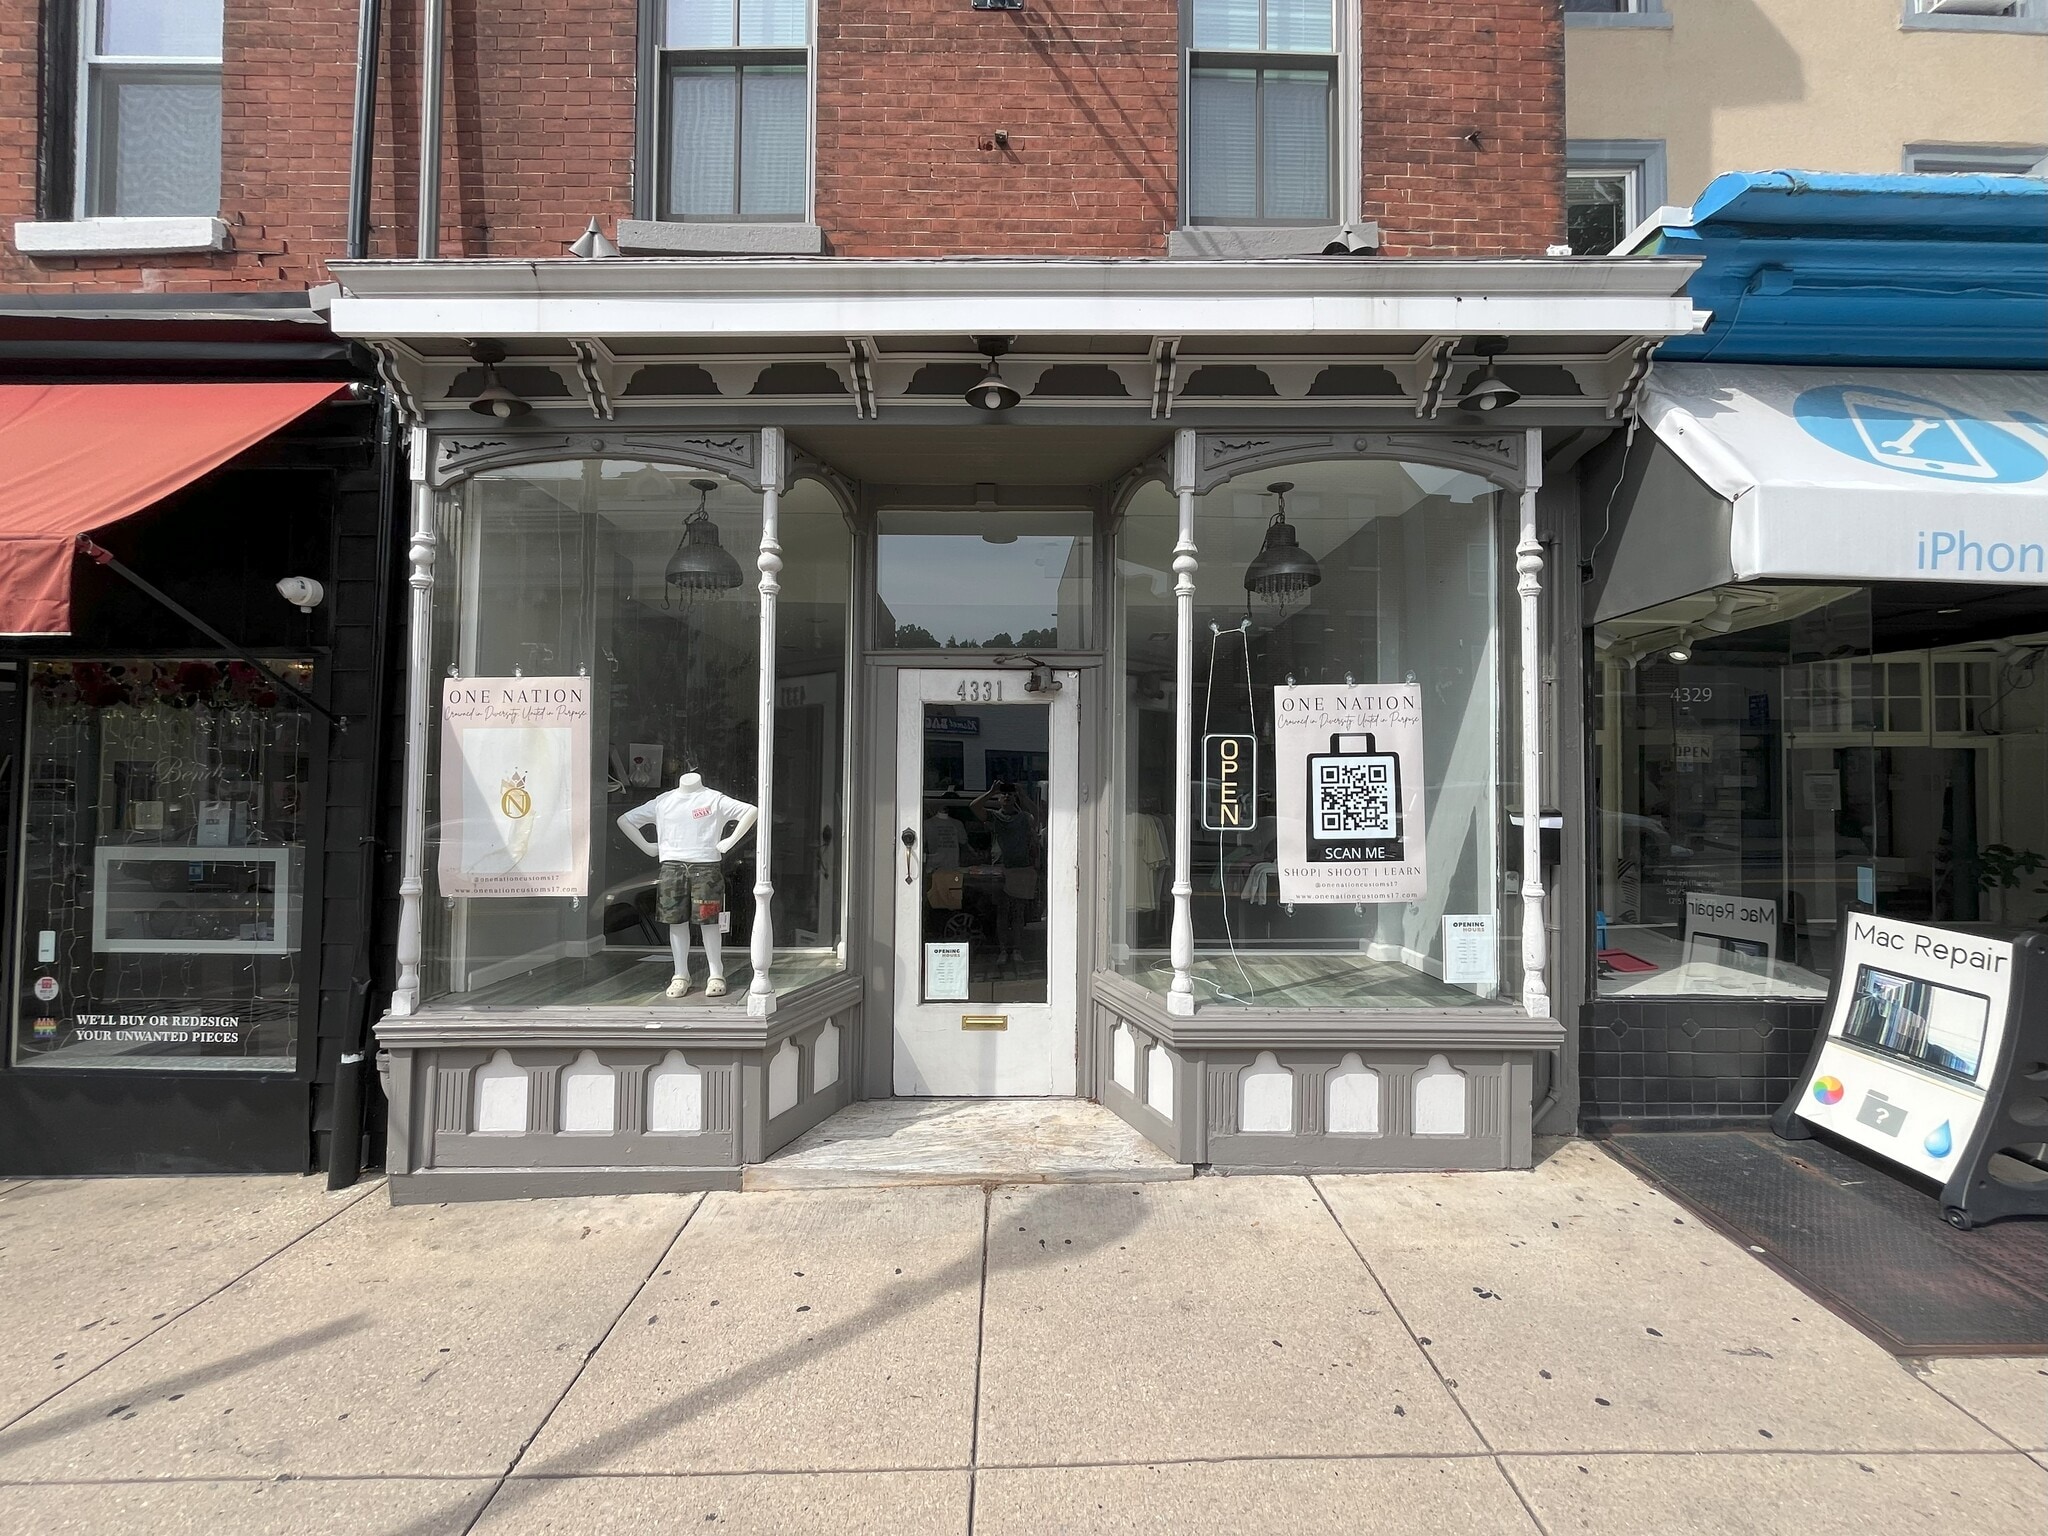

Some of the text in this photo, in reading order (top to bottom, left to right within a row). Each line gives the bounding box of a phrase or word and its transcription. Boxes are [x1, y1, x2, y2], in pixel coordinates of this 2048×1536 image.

[449, 688, 583, 704] ONE NATION
[957, 679, 1003, 702] 4331
[1669, 687, 1713, 703] 4329
[1281, 695, 1415, 712] ONE NATION
[522, 707, 546, 721] United
[556, 704, 587, 722] Purpose
[1357, 713, 1379, 729] United
[1389, 710, 1420, 729] Purpose
[1220, 739, 1239, 825] OPEN
[1325, 846, 1386, 860] SCAN ME
[474, 874, 560, 883] @onenationcustoms17
[1327, 867, 1369, 877] SHOOT
[1384, 866, 1422, 876] LEARN
[455, 886, 578, 894] www.onenationcustoms17.com
[1315, 881, 1399, 889] @onenationcustoms17
[1295, 892, 1418, 900] www.onenationcustoms17.com
[1854, 921, 2008, 973] Mac Repair
[76, 1015, 239, 1027] WE'LL BUY OR REDESIGN
[76, 1030, 239, 1043] YOUR UNWANTED PIECES
